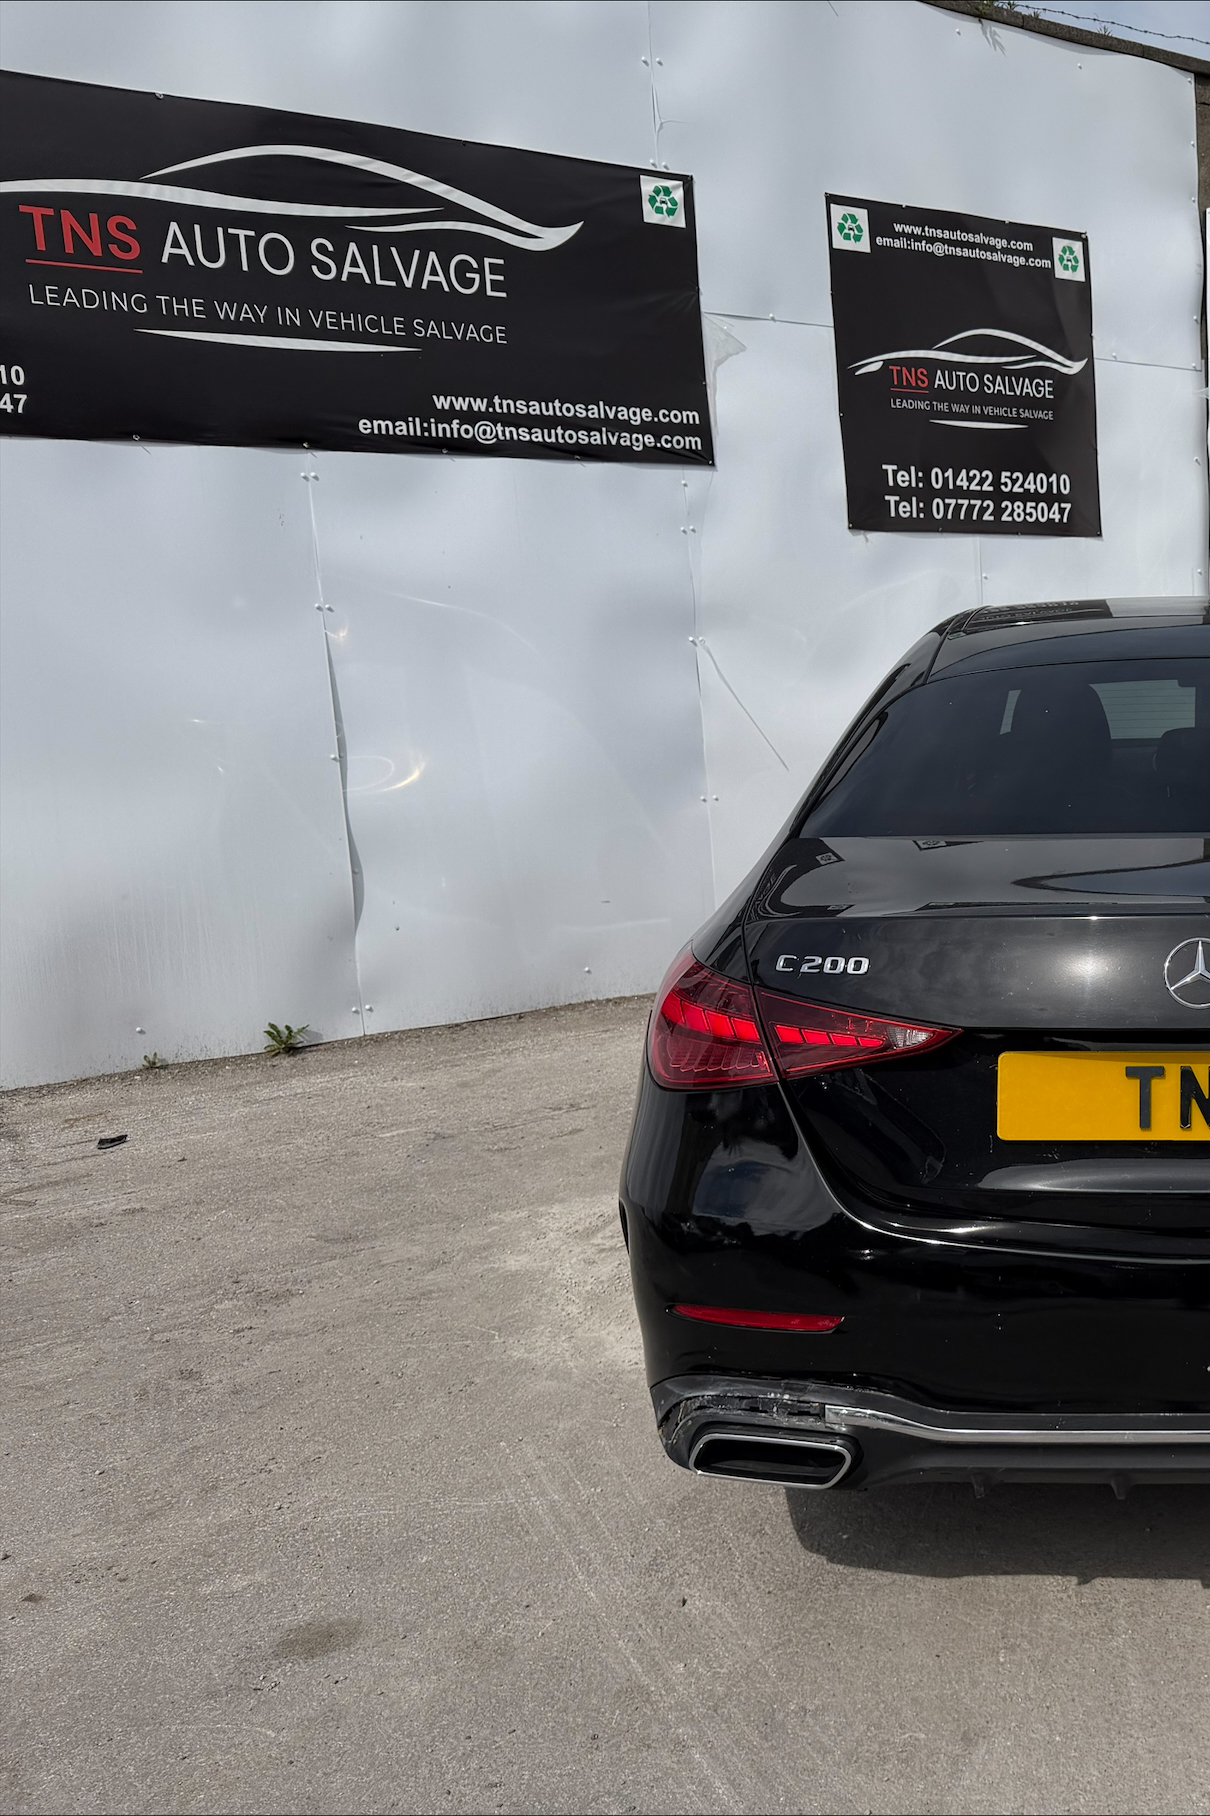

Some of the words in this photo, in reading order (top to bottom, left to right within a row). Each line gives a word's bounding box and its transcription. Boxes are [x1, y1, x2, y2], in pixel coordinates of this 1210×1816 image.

[19, 205, 140, 259] TNS
[162, 222, 294, 275] AUTO
[311, 238, 506, 297] SALVAGE
[894, 223, 1033, 251] www.tnsautosalvage.com
[876, 237, 1051, 268] email:info@tnsautosalvage.com
[30, 285, 147, 312] LEADING
[156, 296, 206, 318] THE
[214, 301, 267, 323] WAY
[278, 307, 300, 326] IN
[309, 310, 405, 335] VEHICLE
[414, 319, 507, 343] SALVAGE
[889, 366, 928, 387] TNS
[935, 370, 979, 392] AUTO
[984, 374, 1053, 398] SALVAGE
[433, 395, 699, 425] www.tnsautosalvage.com
[891, 399, 930, 410] LEADING
[933, 402, 949, 411] THE
[951, 404, 969, 413] WAY
[972, 406, 980, 414] IN
[983, 406, 1017, 417] VEHICLE
[1020, 409, 1053, 420] SALVAGE
[359, 417, 701, 451] email:info@tnsautosalvage.com
[882, 465, 923, 487] Tel:
[931, 468, 993, 491] 01422
[1001, 472, 1070, 494] 524010
[885, 496, 924, 518] Tel:
[933, 498, 994, 520] 07772
[1001, 501, 1071, 522] 285047
[776, 954, 798, 972] C
[800, 955, 870, 975] 200
